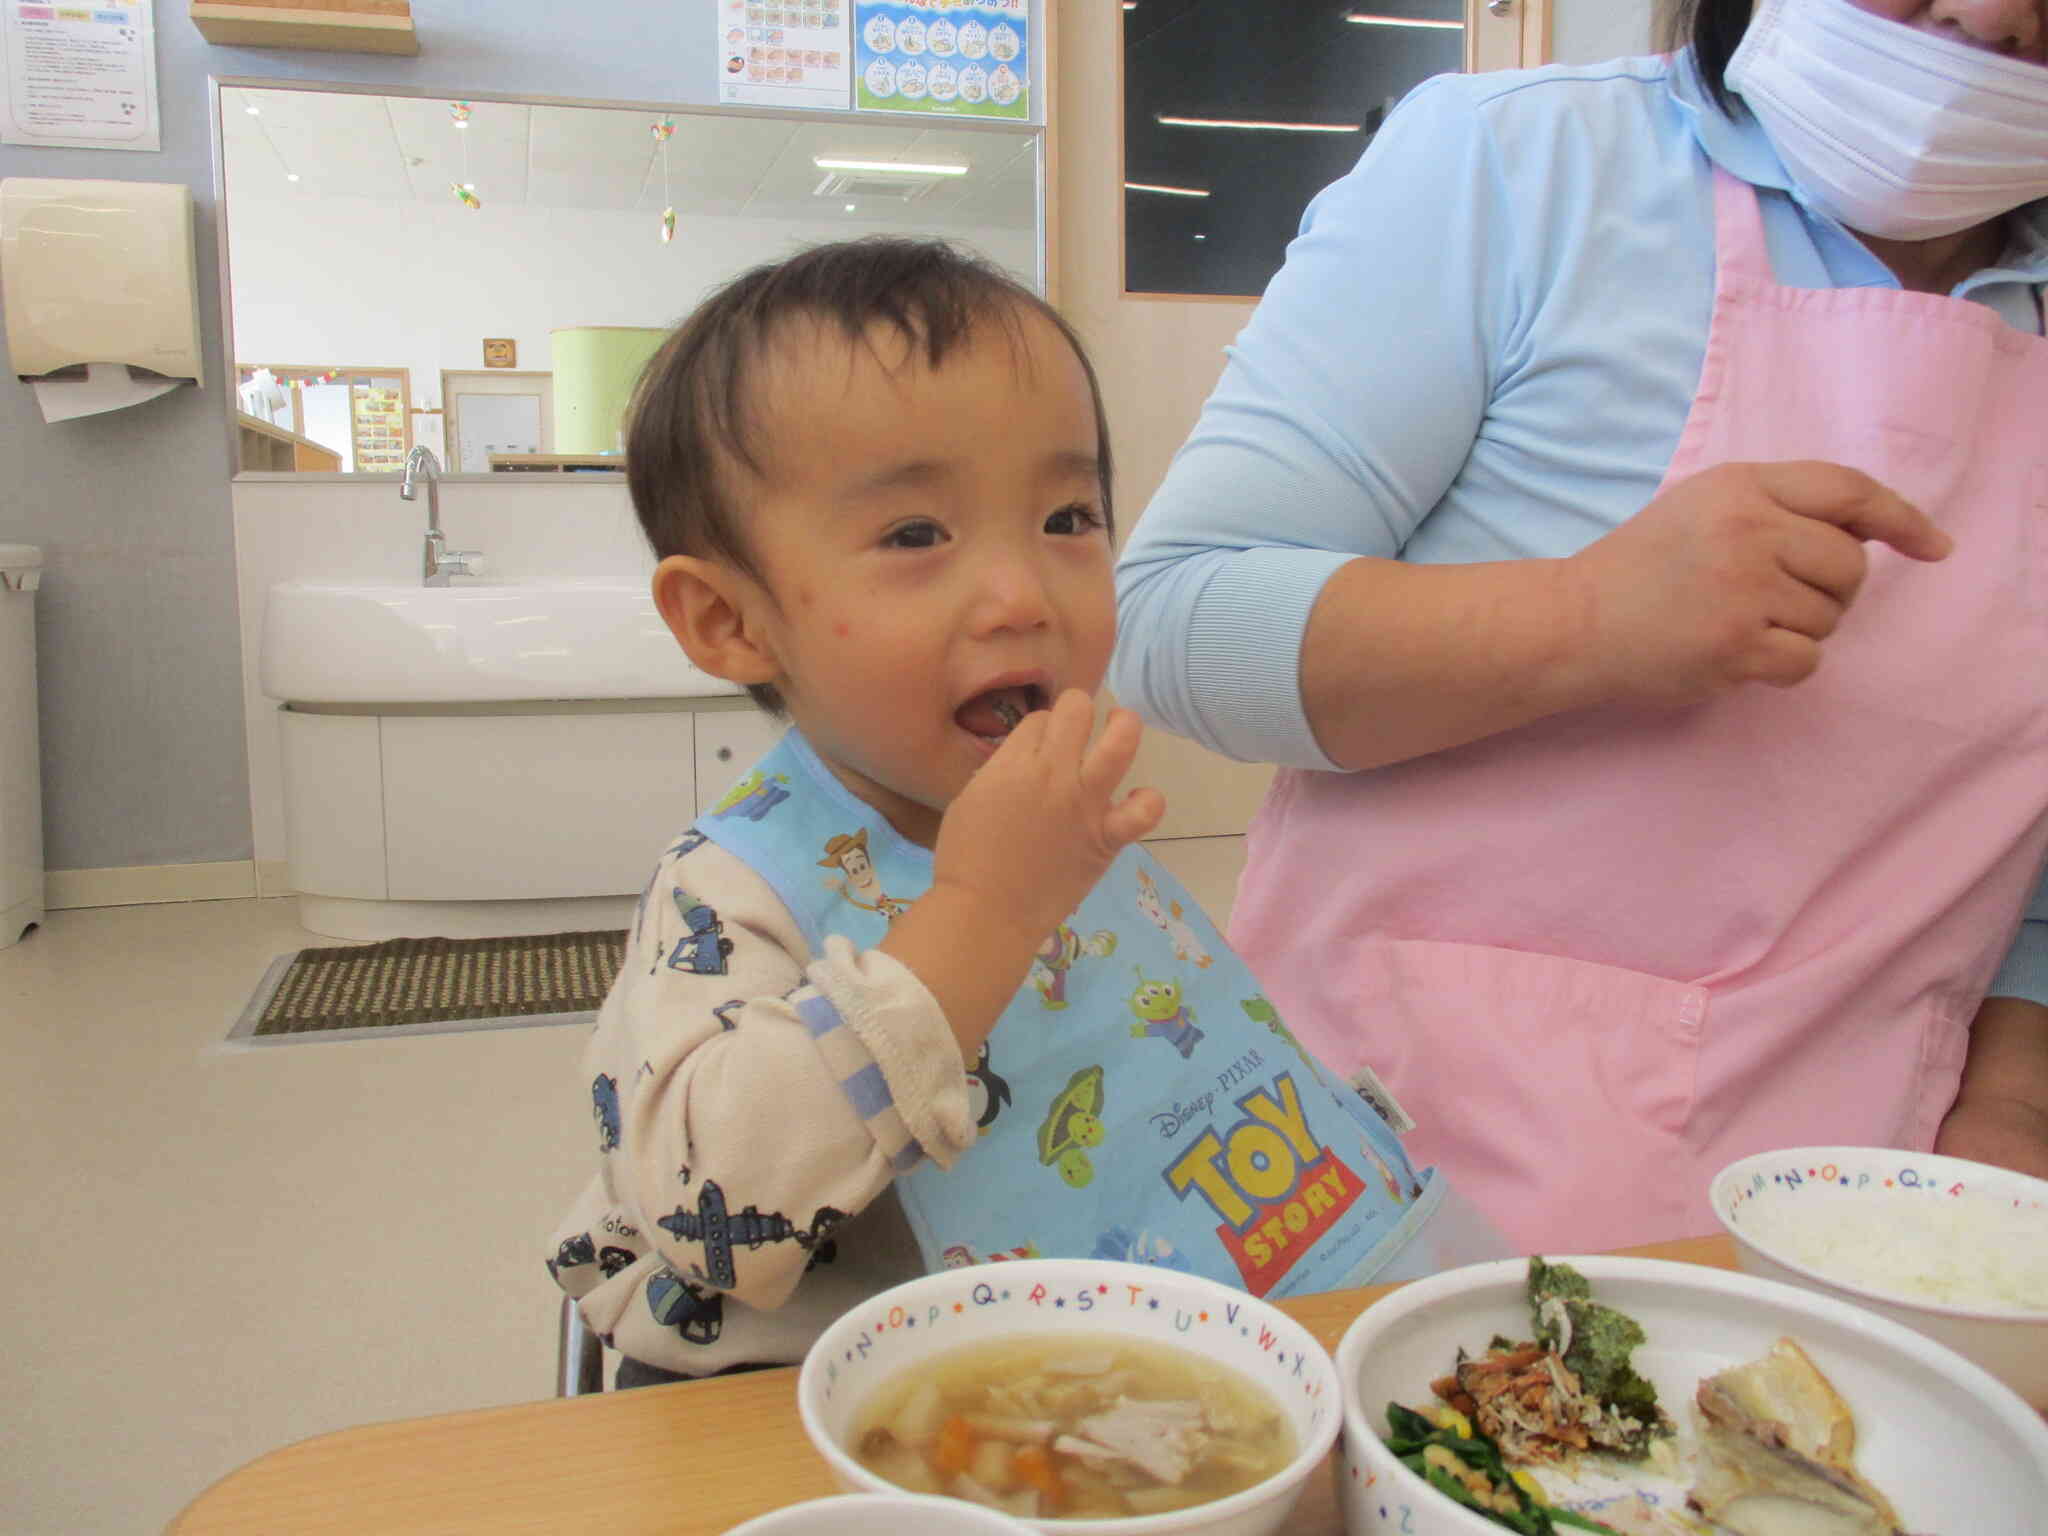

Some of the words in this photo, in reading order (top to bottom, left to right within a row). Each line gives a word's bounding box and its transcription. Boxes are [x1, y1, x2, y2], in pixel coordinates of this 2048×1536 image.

[1216, 1048, 1264, 1092] PIXAR
[1161, 1070, 1326, 1237] TOY
[1784, 1168, 1803, 1191] N
[1821, 1163, 1838, 1182] O
[1857, 1173, 1870, 1190] P
[1899, 1168, 1922, 1188] Q
[1243, 1165, 1349, 1269] STORY
[855, 1331, 873, 1360] N
[887, 1304, 904, 1329] O
[928, 1304, 940, 1329] P
[972, 1283, 997, 1305] Q
[1029, 1283, 1046, 1305] R
[1077, 1289, 1094, 1311] S
[1127, 1284, 1144, 1305] T
[1175, 1308, 1193, 1332] U
[1226, 1303, 1240, 1325] V
[1258, 1323, 1278, 1351] W
[1292, 1352, 1305, 1377] X
